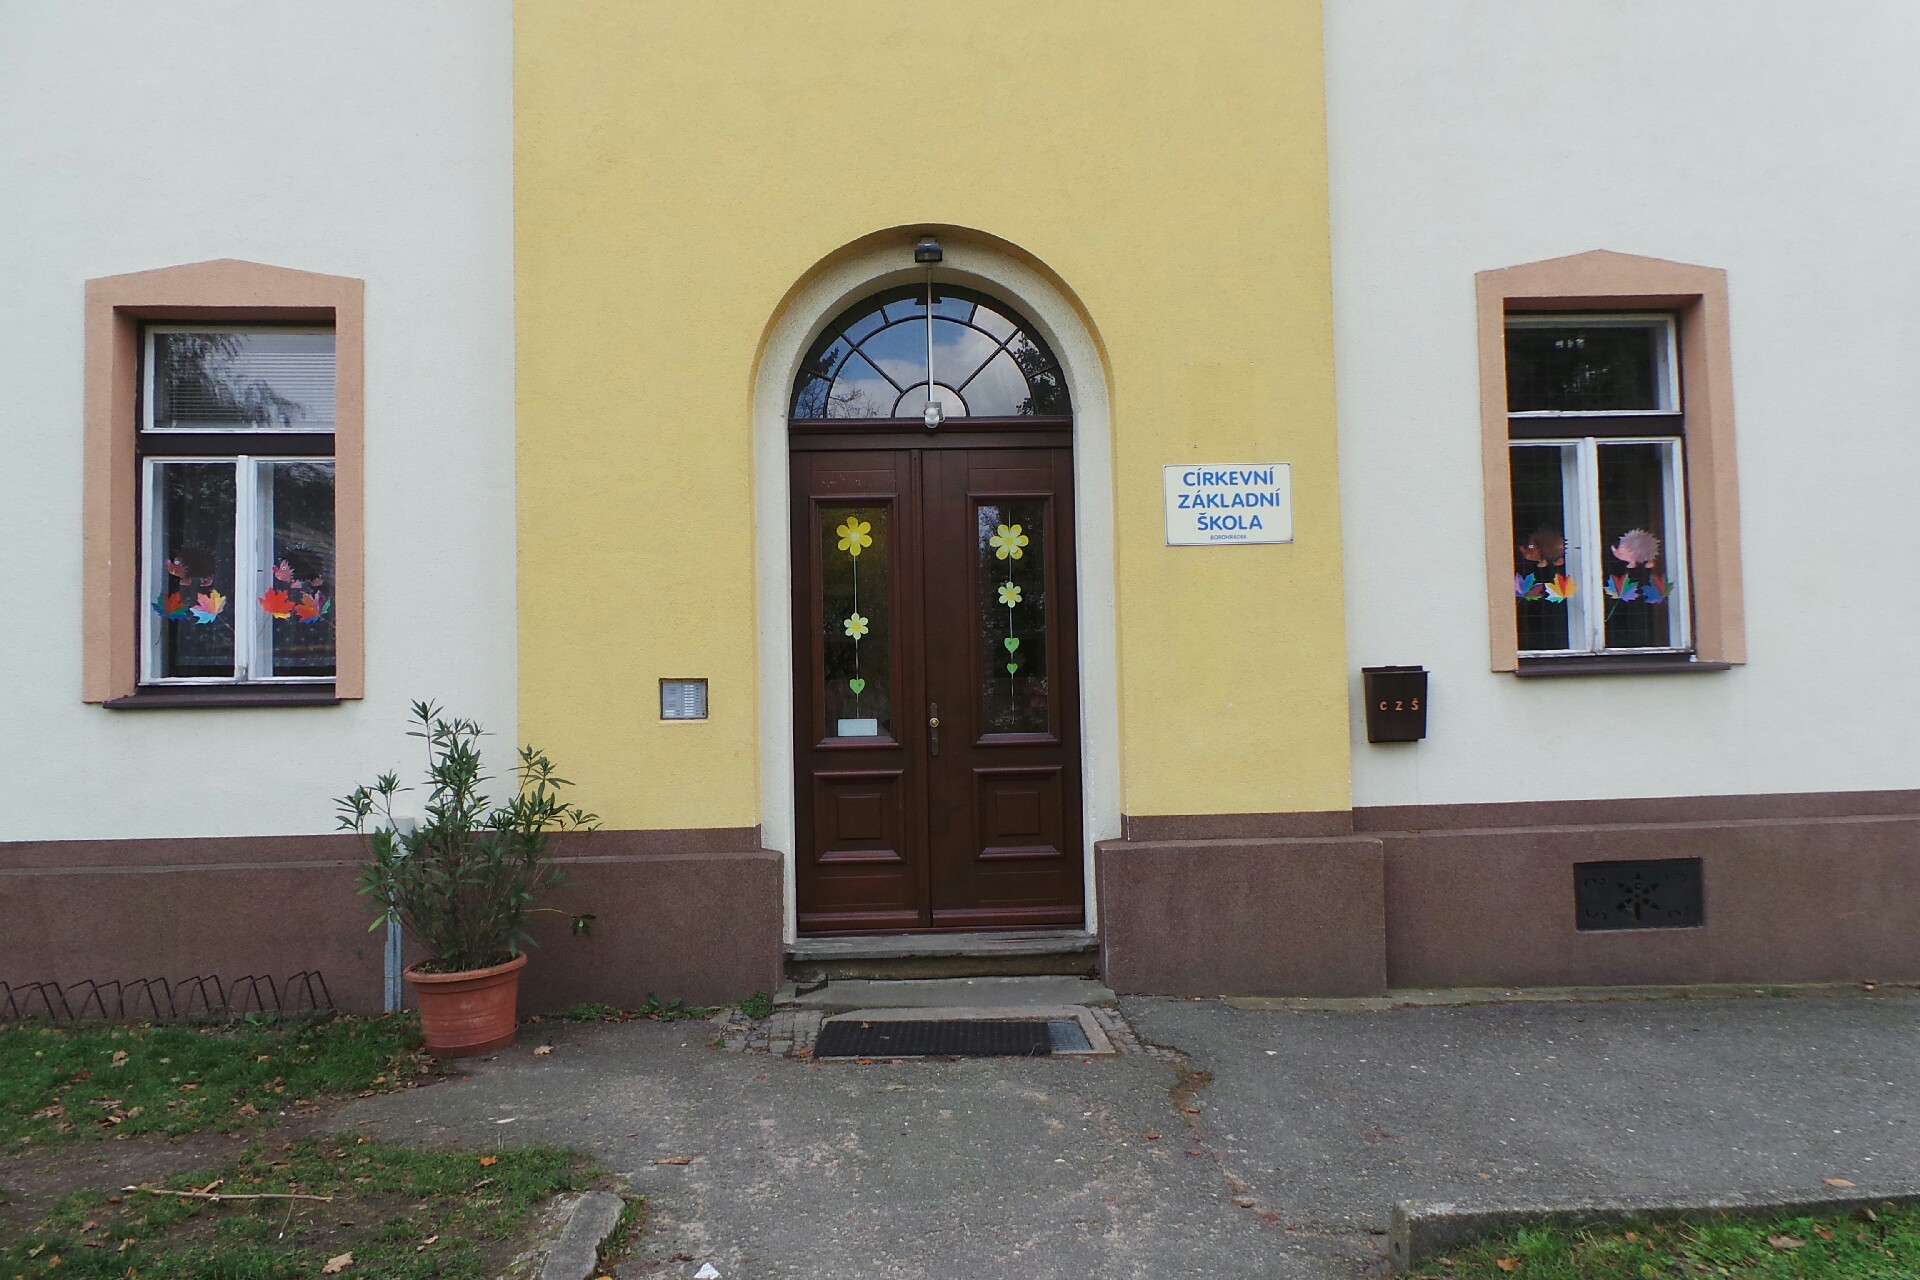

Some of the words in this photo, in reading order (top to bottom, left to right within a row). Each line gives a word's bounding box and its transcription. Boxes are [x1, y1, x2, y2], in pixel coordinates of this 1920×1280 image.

[1183, 467, 1274, 486] CÍRKEVNÍ
[1178, 488, 1280, 509] ZÁKLADNÍ
[1197, 512, 1263, 531] ŠKOLA
